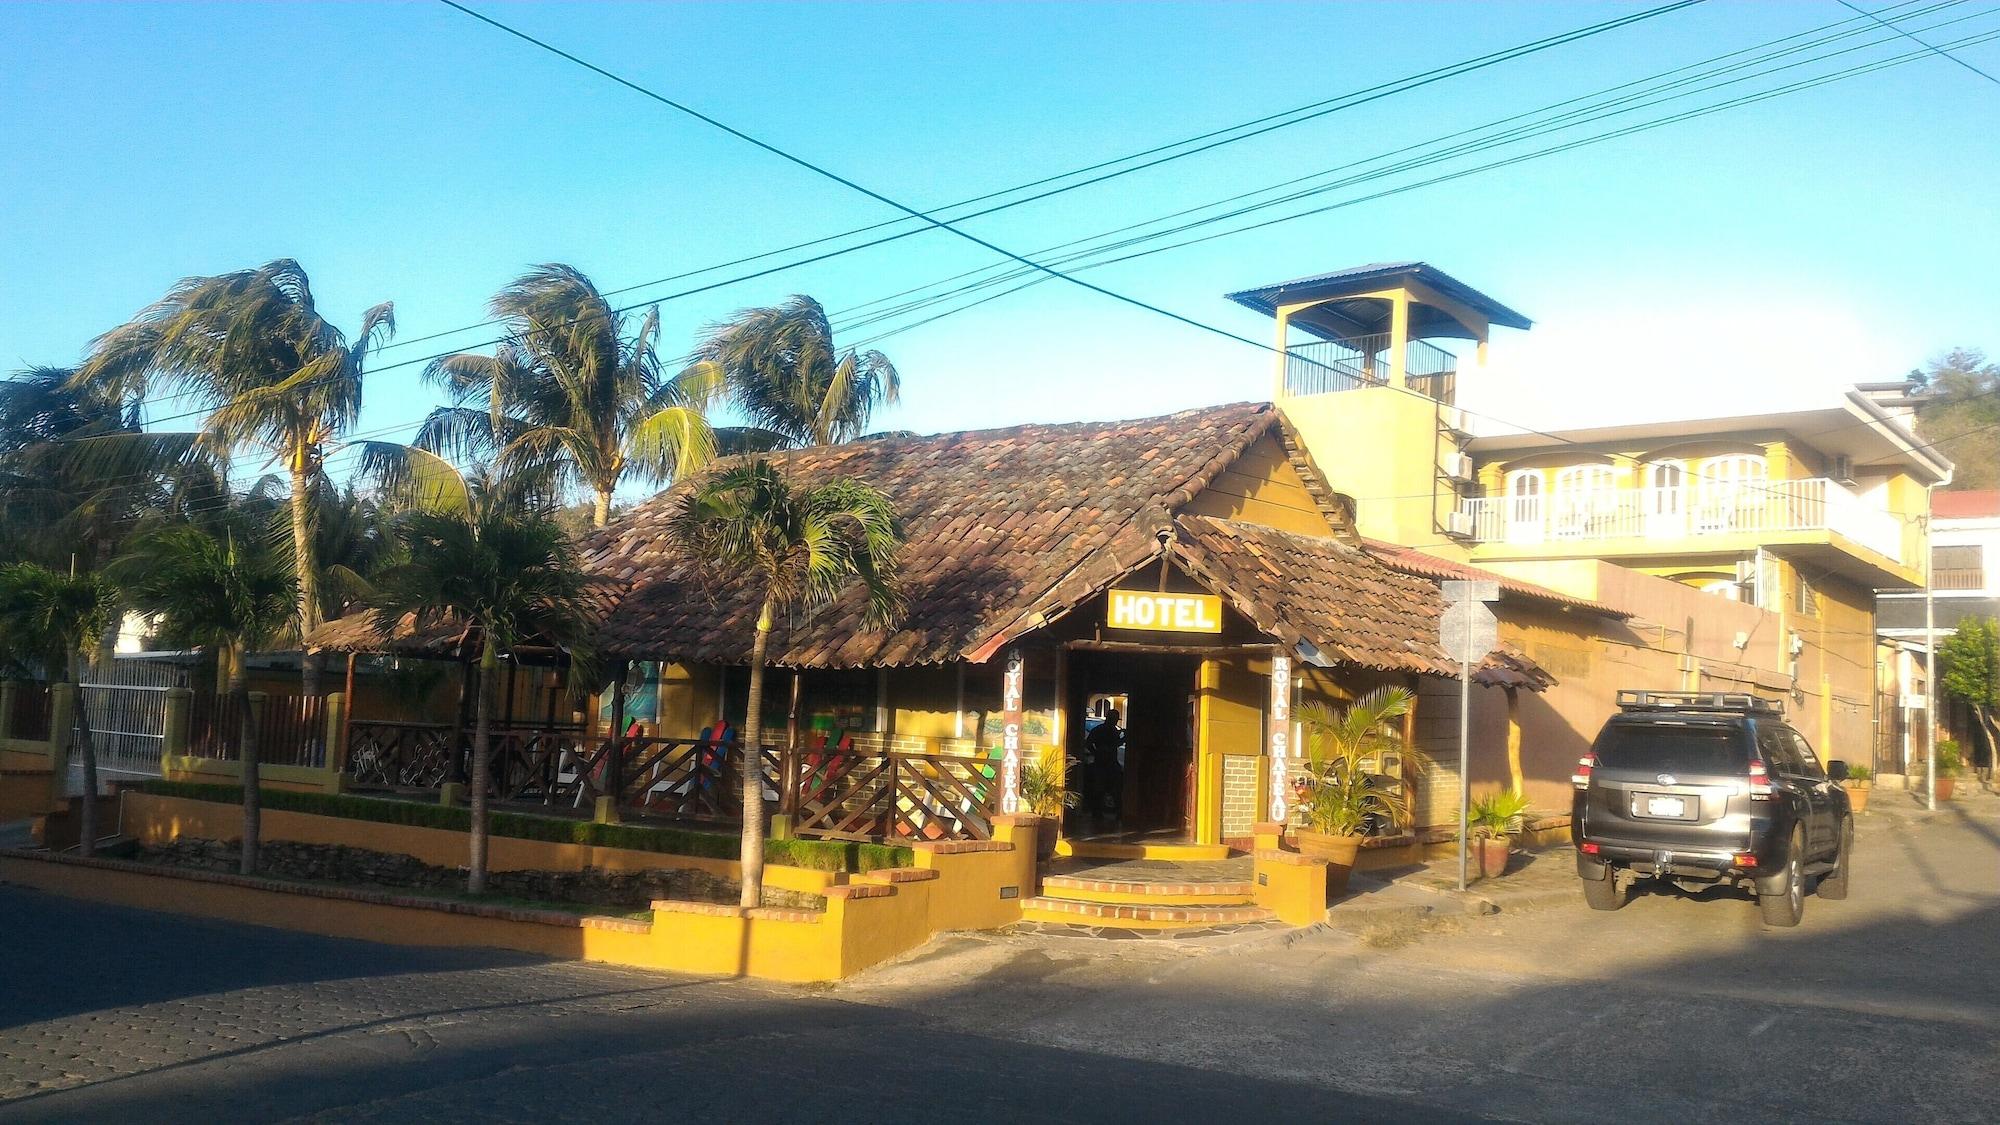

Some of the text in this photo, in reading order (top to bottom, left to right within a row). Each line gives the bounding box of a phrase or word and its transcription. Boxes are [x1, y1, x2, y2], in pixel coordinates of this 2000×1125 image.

[1115, 595, 1214, 628] HOTEL
[1002, 648, 1021, 814] ROYAL CHATEAU
[1272, 657, 1288, 821] ROYAL CHATEAU
